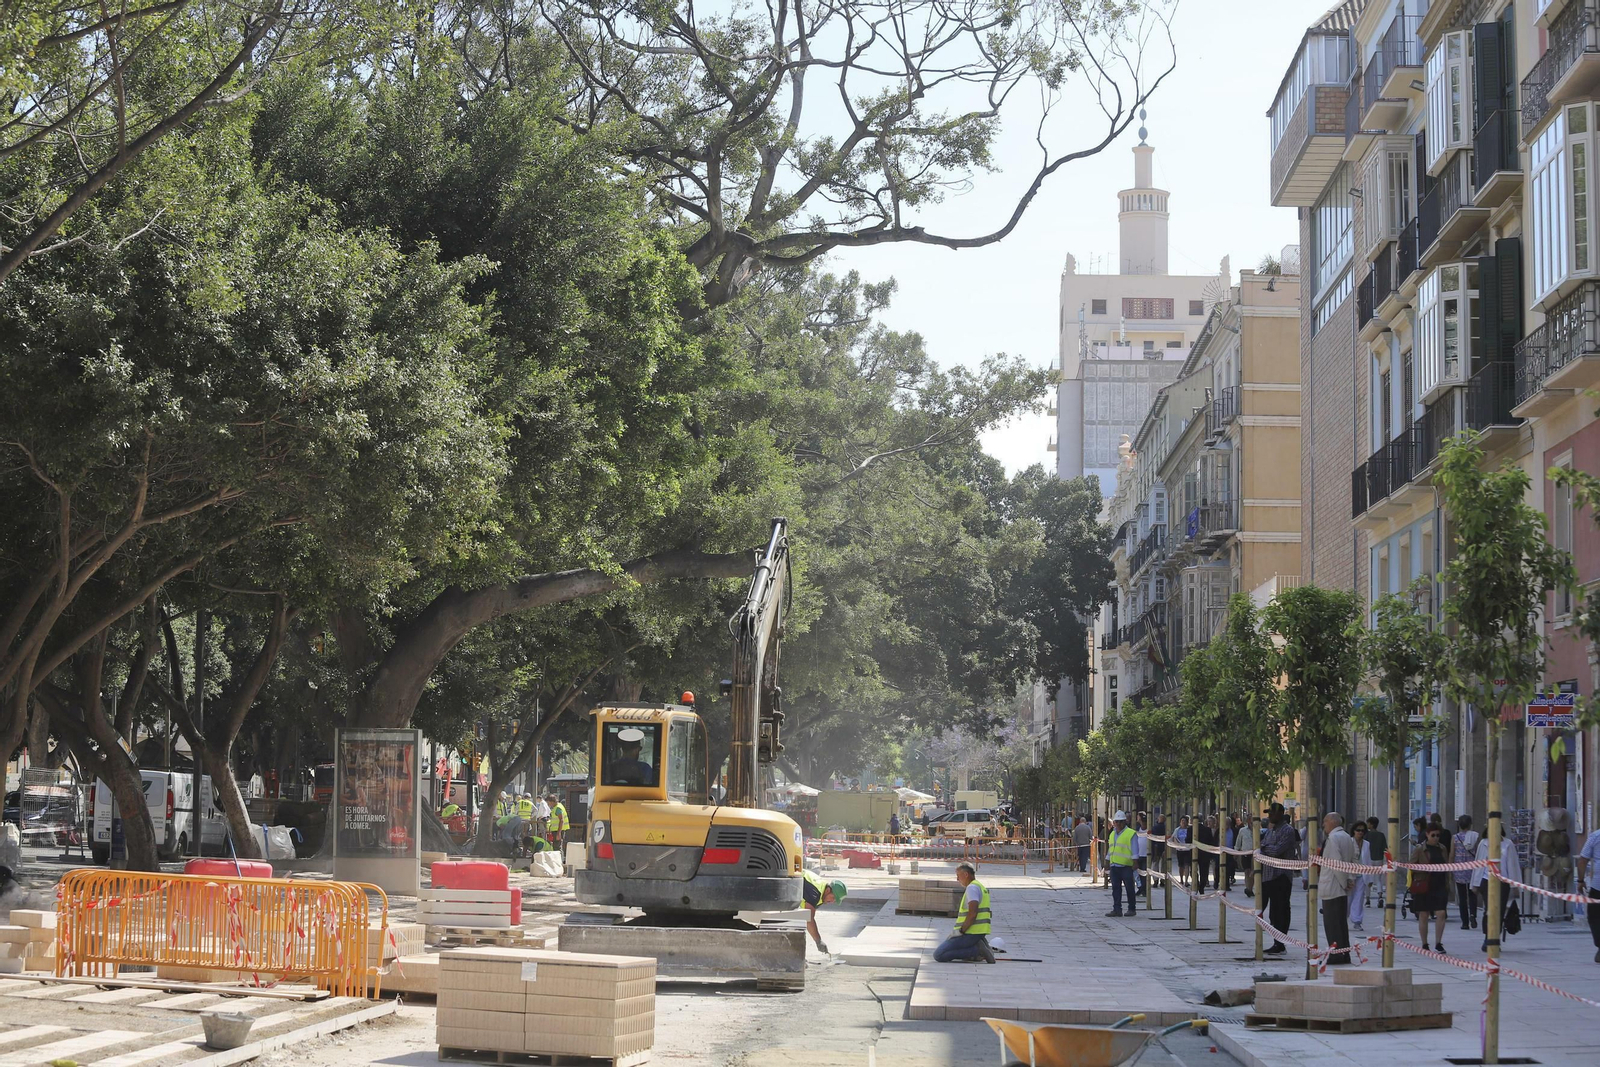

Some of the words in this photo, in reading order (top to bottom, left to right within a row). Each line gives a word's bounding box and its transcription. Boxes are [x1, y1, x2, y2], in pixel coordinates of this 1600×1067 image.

[1532, 697, 1570, 705] Alimentación
[345, 806, 352, 814] ES
[353, 806, 368, 814] HORA
[345, 822, 349, 830] A
[350, 822, 371, 830] COMER.
